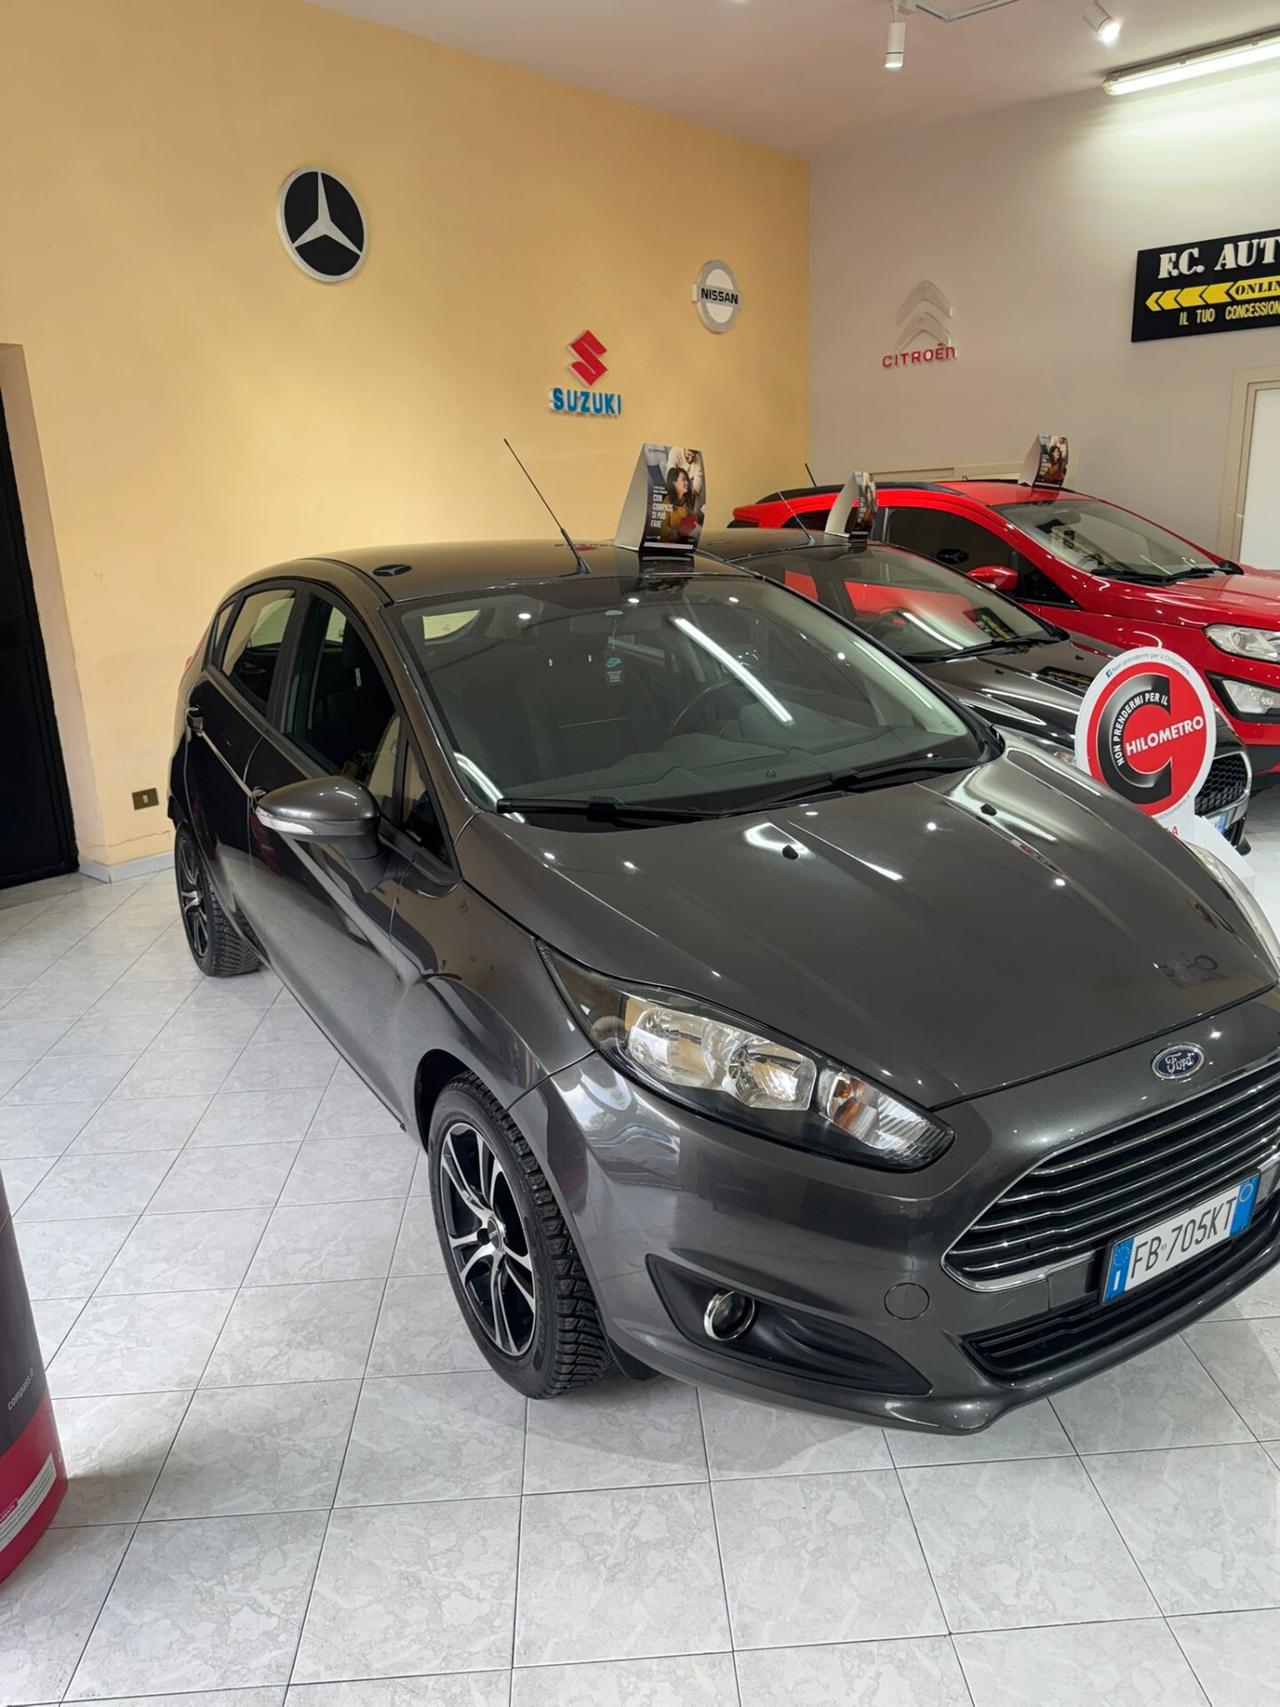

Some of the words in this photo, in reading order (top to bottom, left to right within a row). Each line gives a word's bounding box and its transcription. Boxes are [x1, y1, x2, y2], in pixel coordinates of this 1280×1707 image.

[1158, 247, 1205, 279] F.C.
[701, 287, 739, 305] NISSAN
[1179, 311, 1189, 326] IL
[1196, 308, 1216, 324] TUO
[551, 387, 622, 416] SUZUKI
[1145, 692, 1160, 703] PER
[1160, 694, 1169, 706] IL
[1112, 694, 1144, 742] PRENDERMI
[1113, 744, 1126, 767] NON
[1165, 1052, 1198, 1073] Ford
